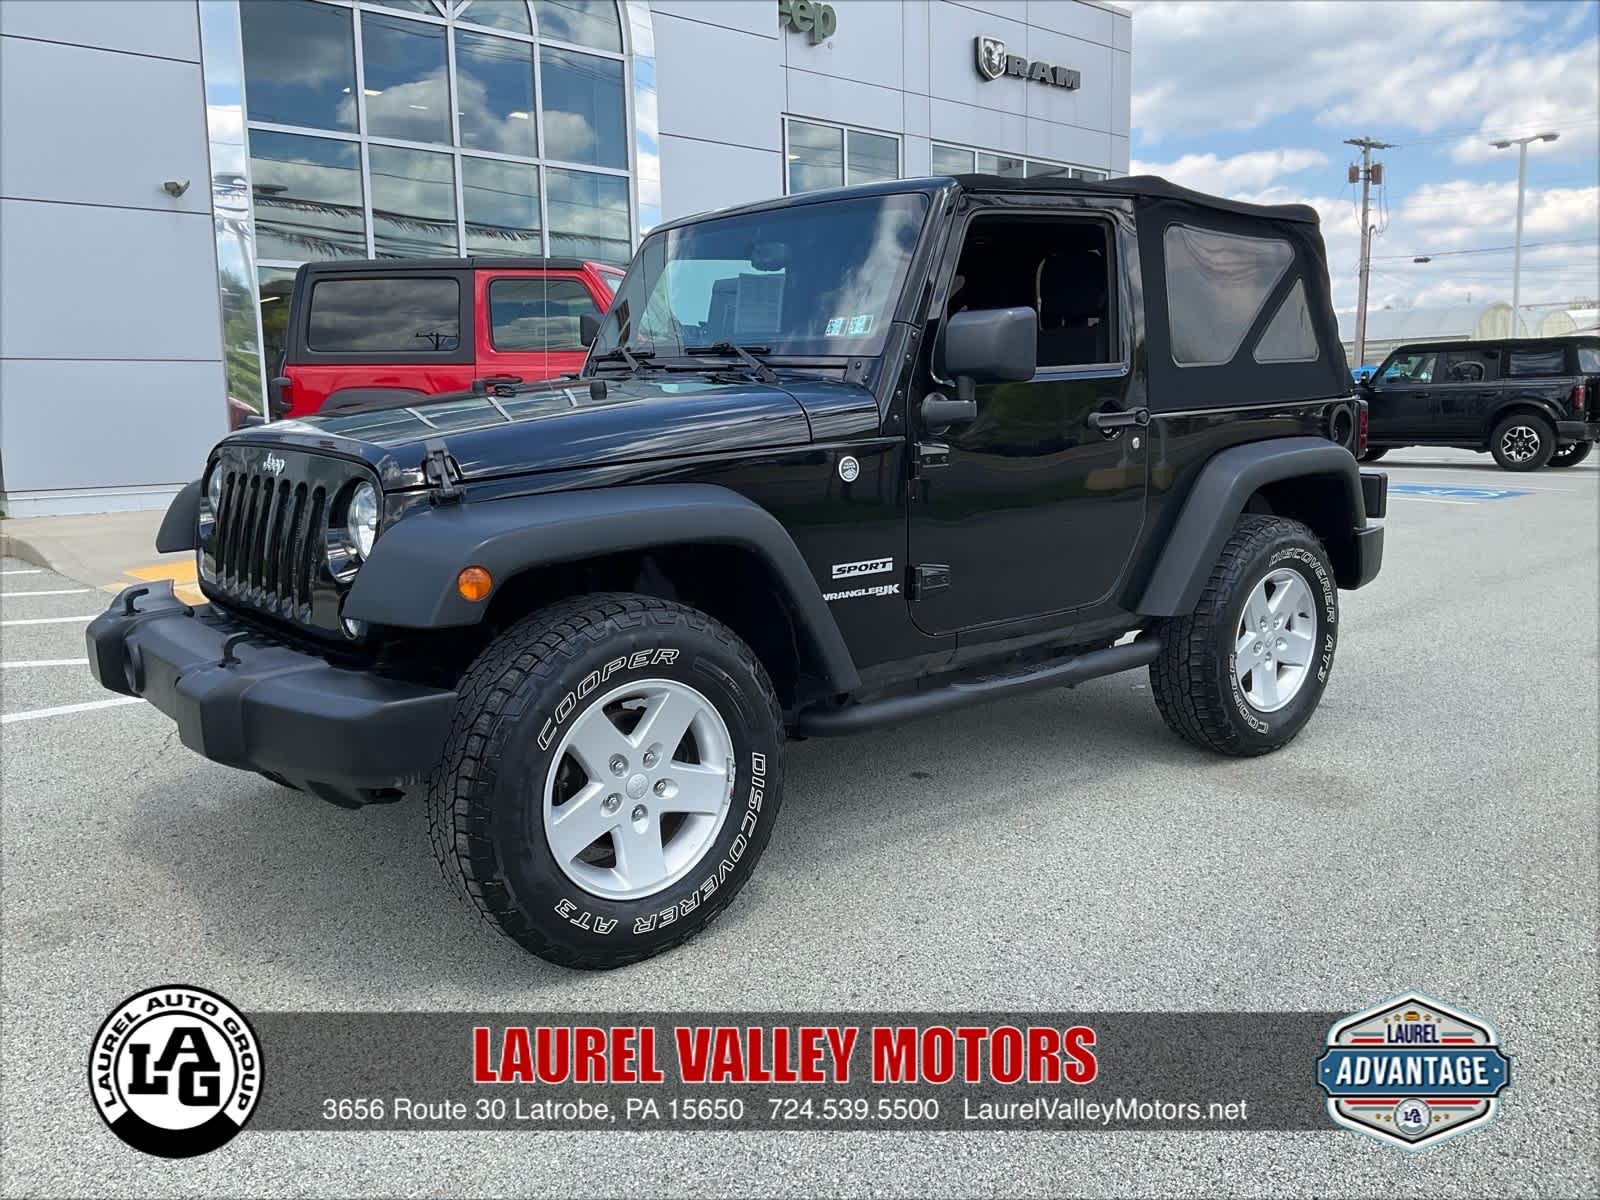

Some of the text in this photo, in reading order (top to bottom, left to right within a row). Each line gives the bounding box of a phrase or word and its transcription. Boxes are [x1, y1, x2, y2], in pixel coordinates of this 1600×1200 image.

[779, 0, 836, 44] eep
[1007, 55, 1080, 88] RAM
[836, 561, 889, 574] SPORT
[1269, 548, 1336, 623] DISCOVERER
[1317, 633, 1334, 682] AT3
[537, 649, 679, 751] COOPER
[633, 752, 766, 934] DISCOVERER
[554, 898, 618, 935] AT3
